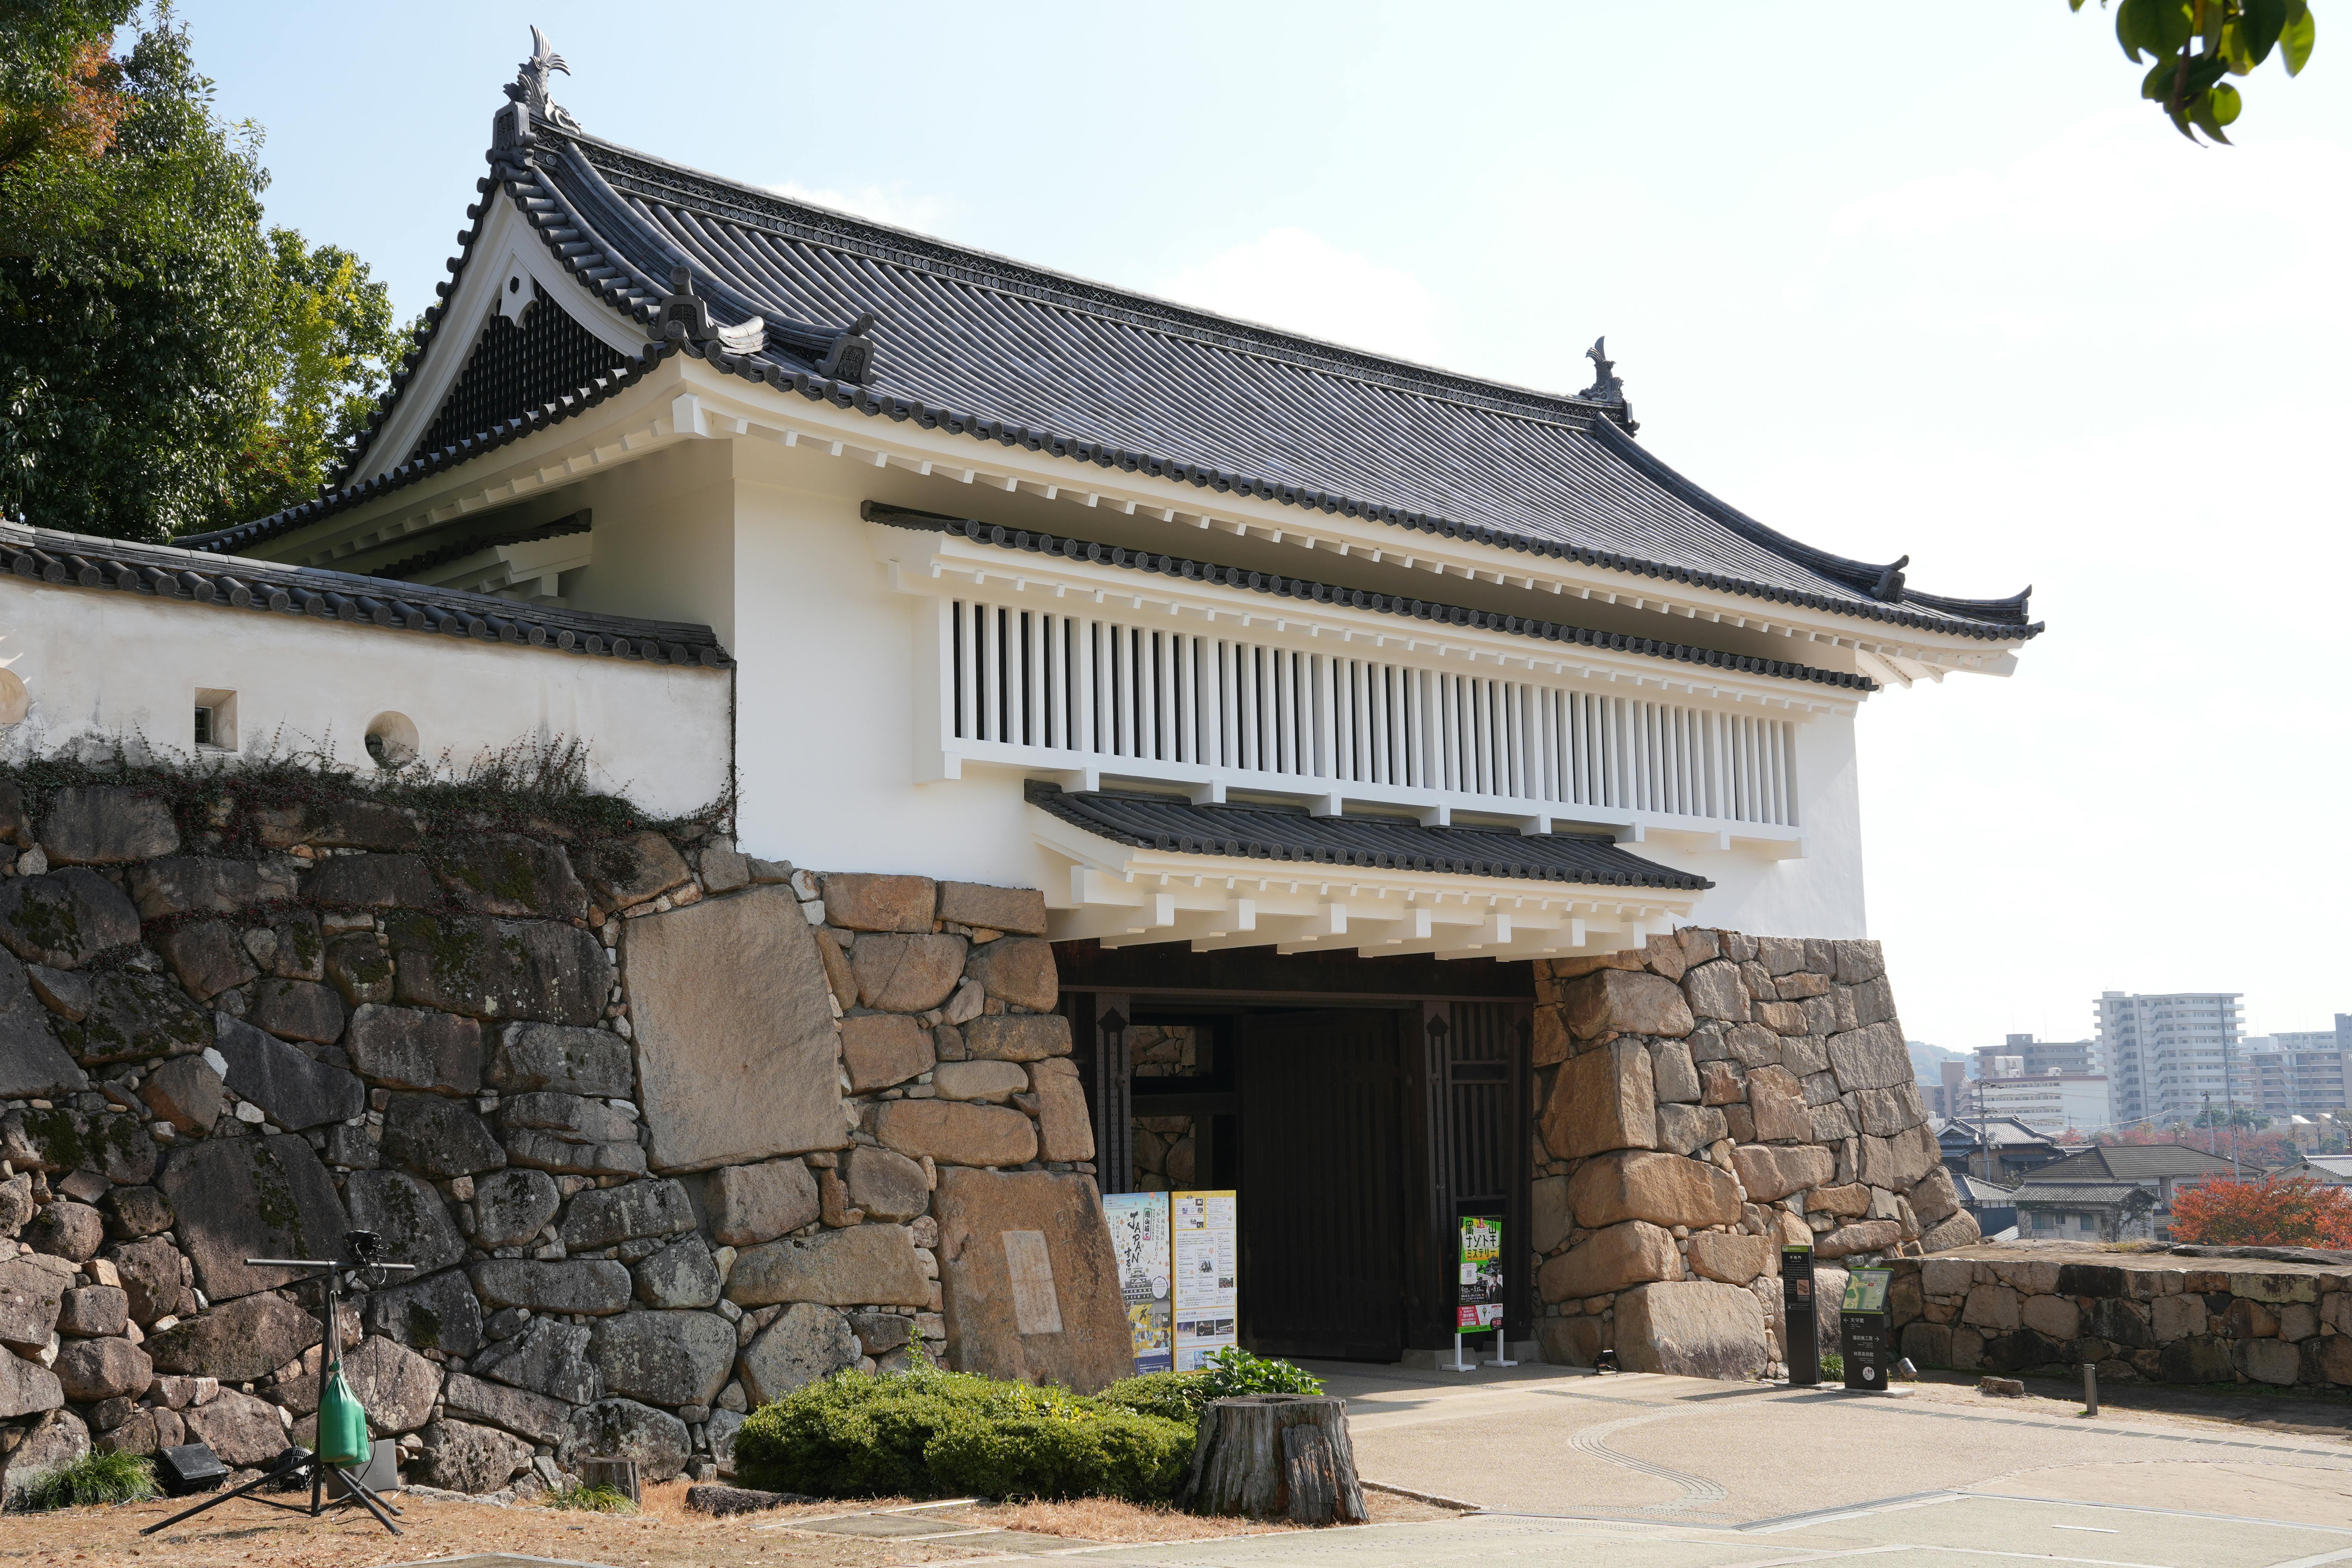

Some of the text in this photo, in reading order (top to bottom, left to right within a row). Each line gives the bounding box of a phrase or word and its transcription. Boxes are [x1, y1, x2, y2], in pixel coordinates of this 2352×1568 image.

[1127, 1211, 1141, 1263] JAPAN
[1466, 1234, 1496, 1248] ナゾトキ
[1467, 1248, 1496, 1258] ミステリー
